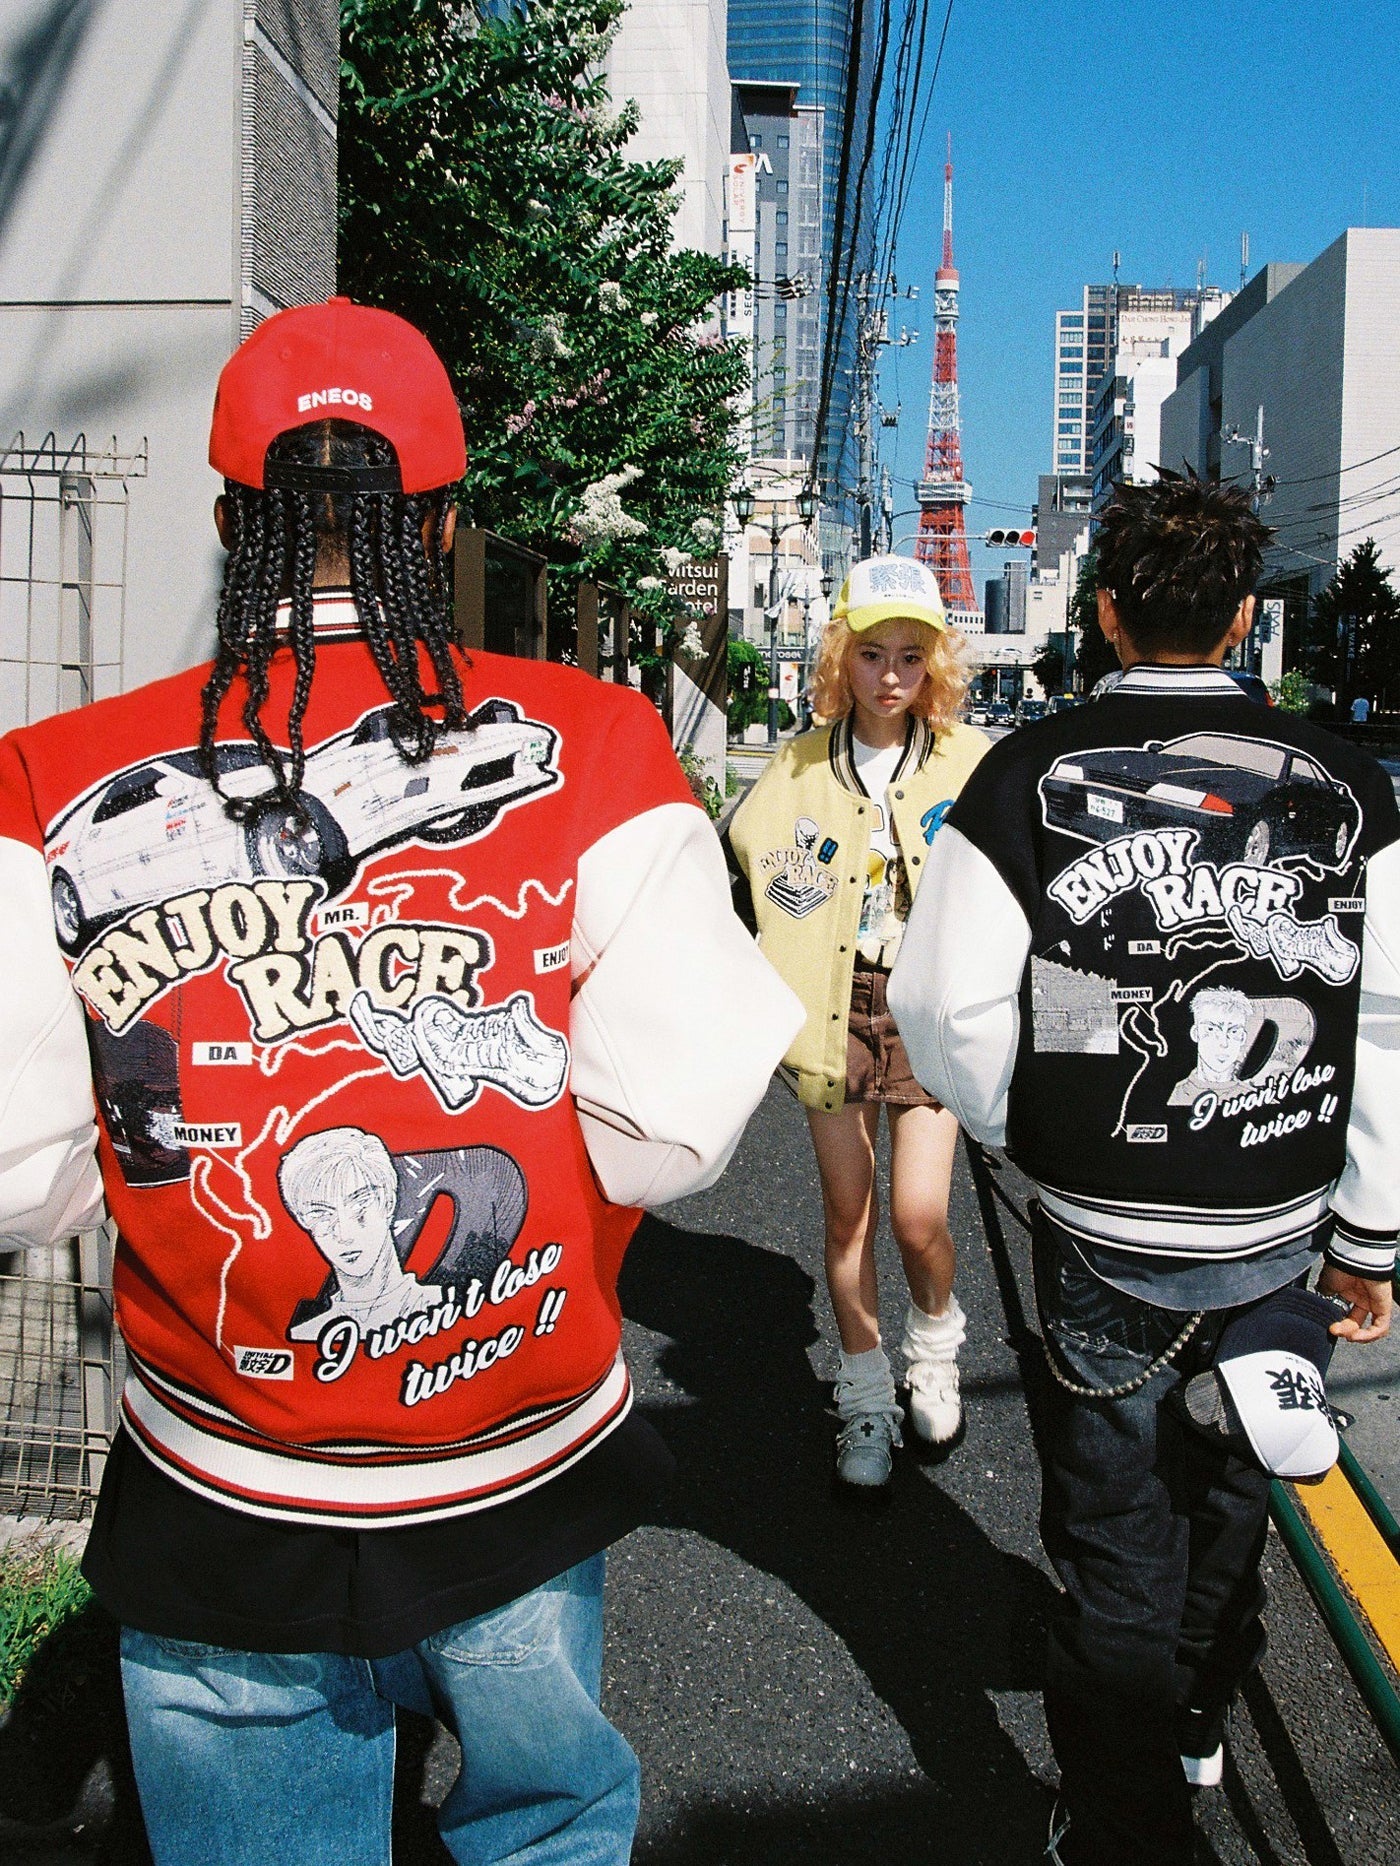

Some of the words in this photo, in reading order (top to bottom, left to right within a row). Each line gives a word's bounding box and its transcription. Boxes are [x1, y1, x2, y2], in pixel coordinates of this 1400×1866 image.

[744, 254, 753, 317] SECITY
[297, 387, 374, 413] ENEOS
[684, 597, 719, 615] otel
[757, 847, 809, 873] ENJOY
[787, 864, 839, 895] RACE
[1051, 831, 1191, 920] ENJOY
[1143, 866, 1295, 927] RACE
[1333, 900, 1363, 910] ENJOY
[324, 908, 360, 925] MR.
[74, 877, 315, 1032] ENJOY
[542, 945, 569, 967] ENJO
[1136, 942, 1154, 952] DA
[231, 928, 480, 1038] RACE
[1110, 989, 1151, 1000] MONEY
[208, 1046, 238, 1061] DA
[1190, 1093, 1217, 1131] I
[1222, 1074, 1290, 1118] won't
[1291, 1064, 1336, 1094] lose
[173, 1126, 238, 1143] MONEY
[1240, 1109, 1312, 1148] twice
[316, 1319, 359, 1382] I
[369, 1278, 485, 1359] won't
[490, 1244, 564, 1305] lose
[403, 1327, 526, 1407] twice
